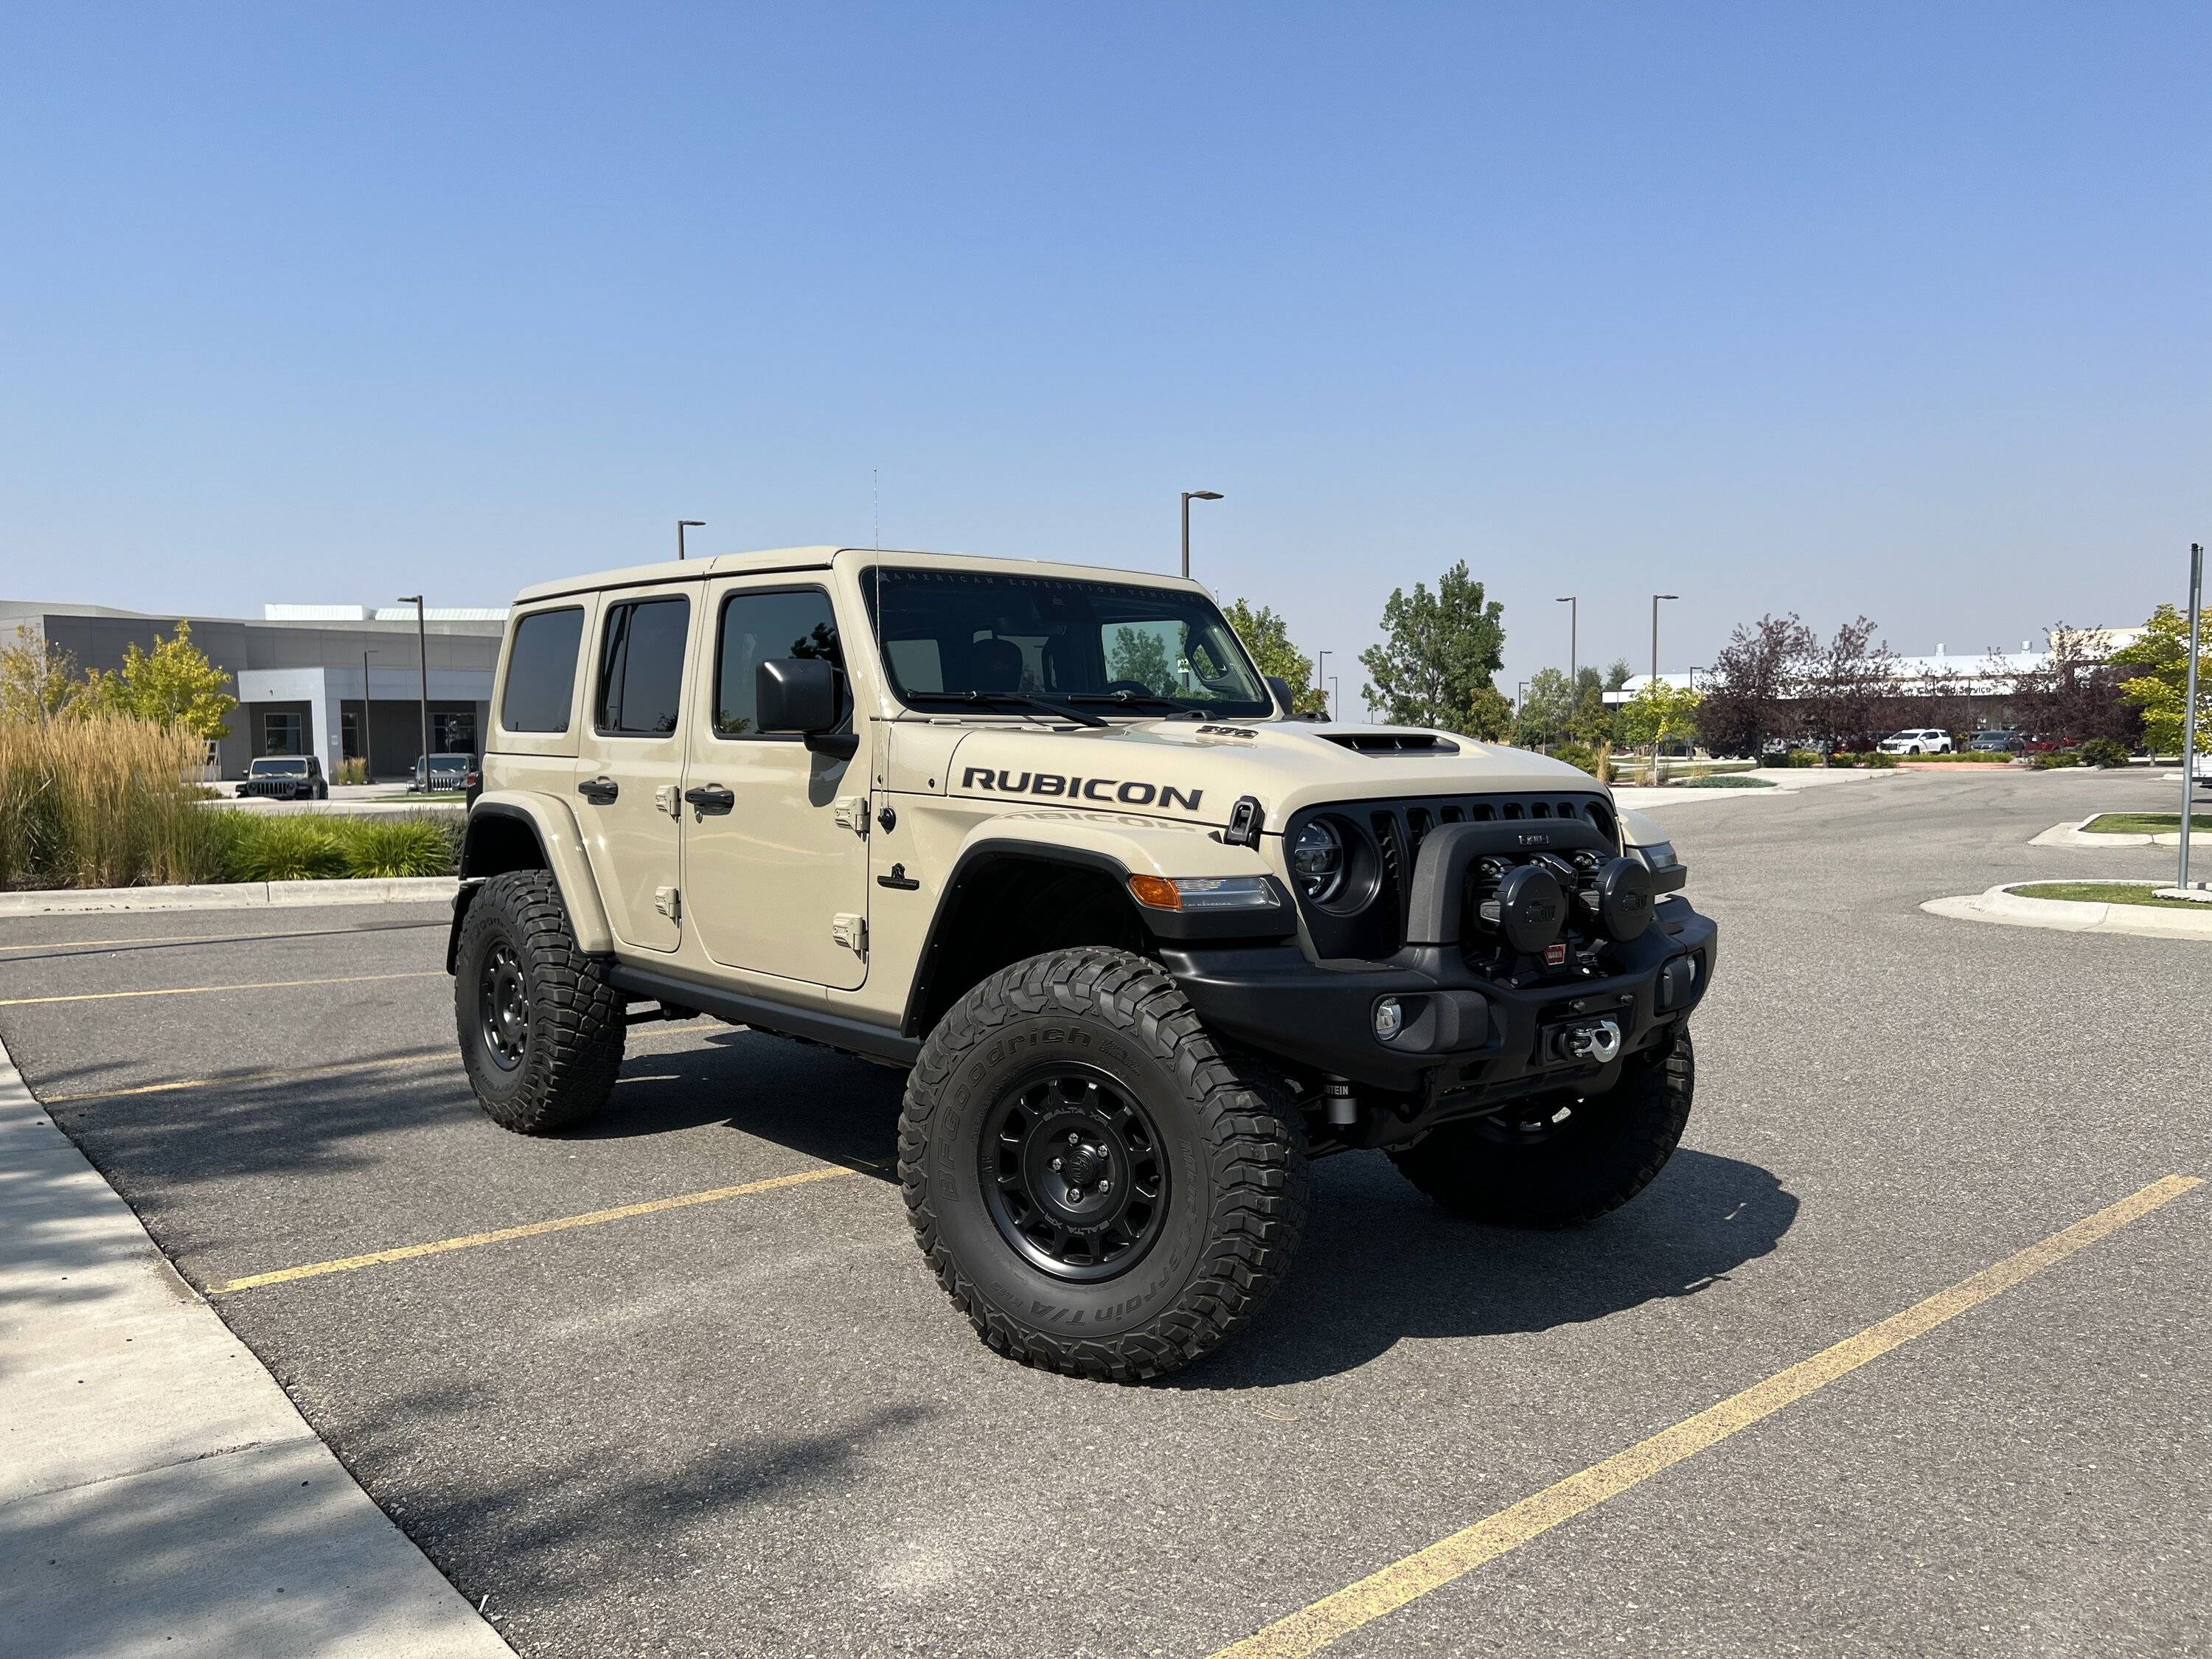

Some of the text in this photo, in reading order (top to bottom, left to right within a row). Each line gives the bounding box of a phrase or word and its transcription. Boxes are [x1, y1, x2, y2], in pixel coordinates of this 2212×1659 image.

[893, 573, 994, 585] AMERICAN
[1009, 579, 1116, 594] EXPEDITION
[961, 766, 1203, 812] RUBICON
[1324, 1085, 1349, 1095] LSTEIN
[937, 1026, 1092, 1203] BFGoodrich
[1030, 1300, 1087, 1326] T/A
